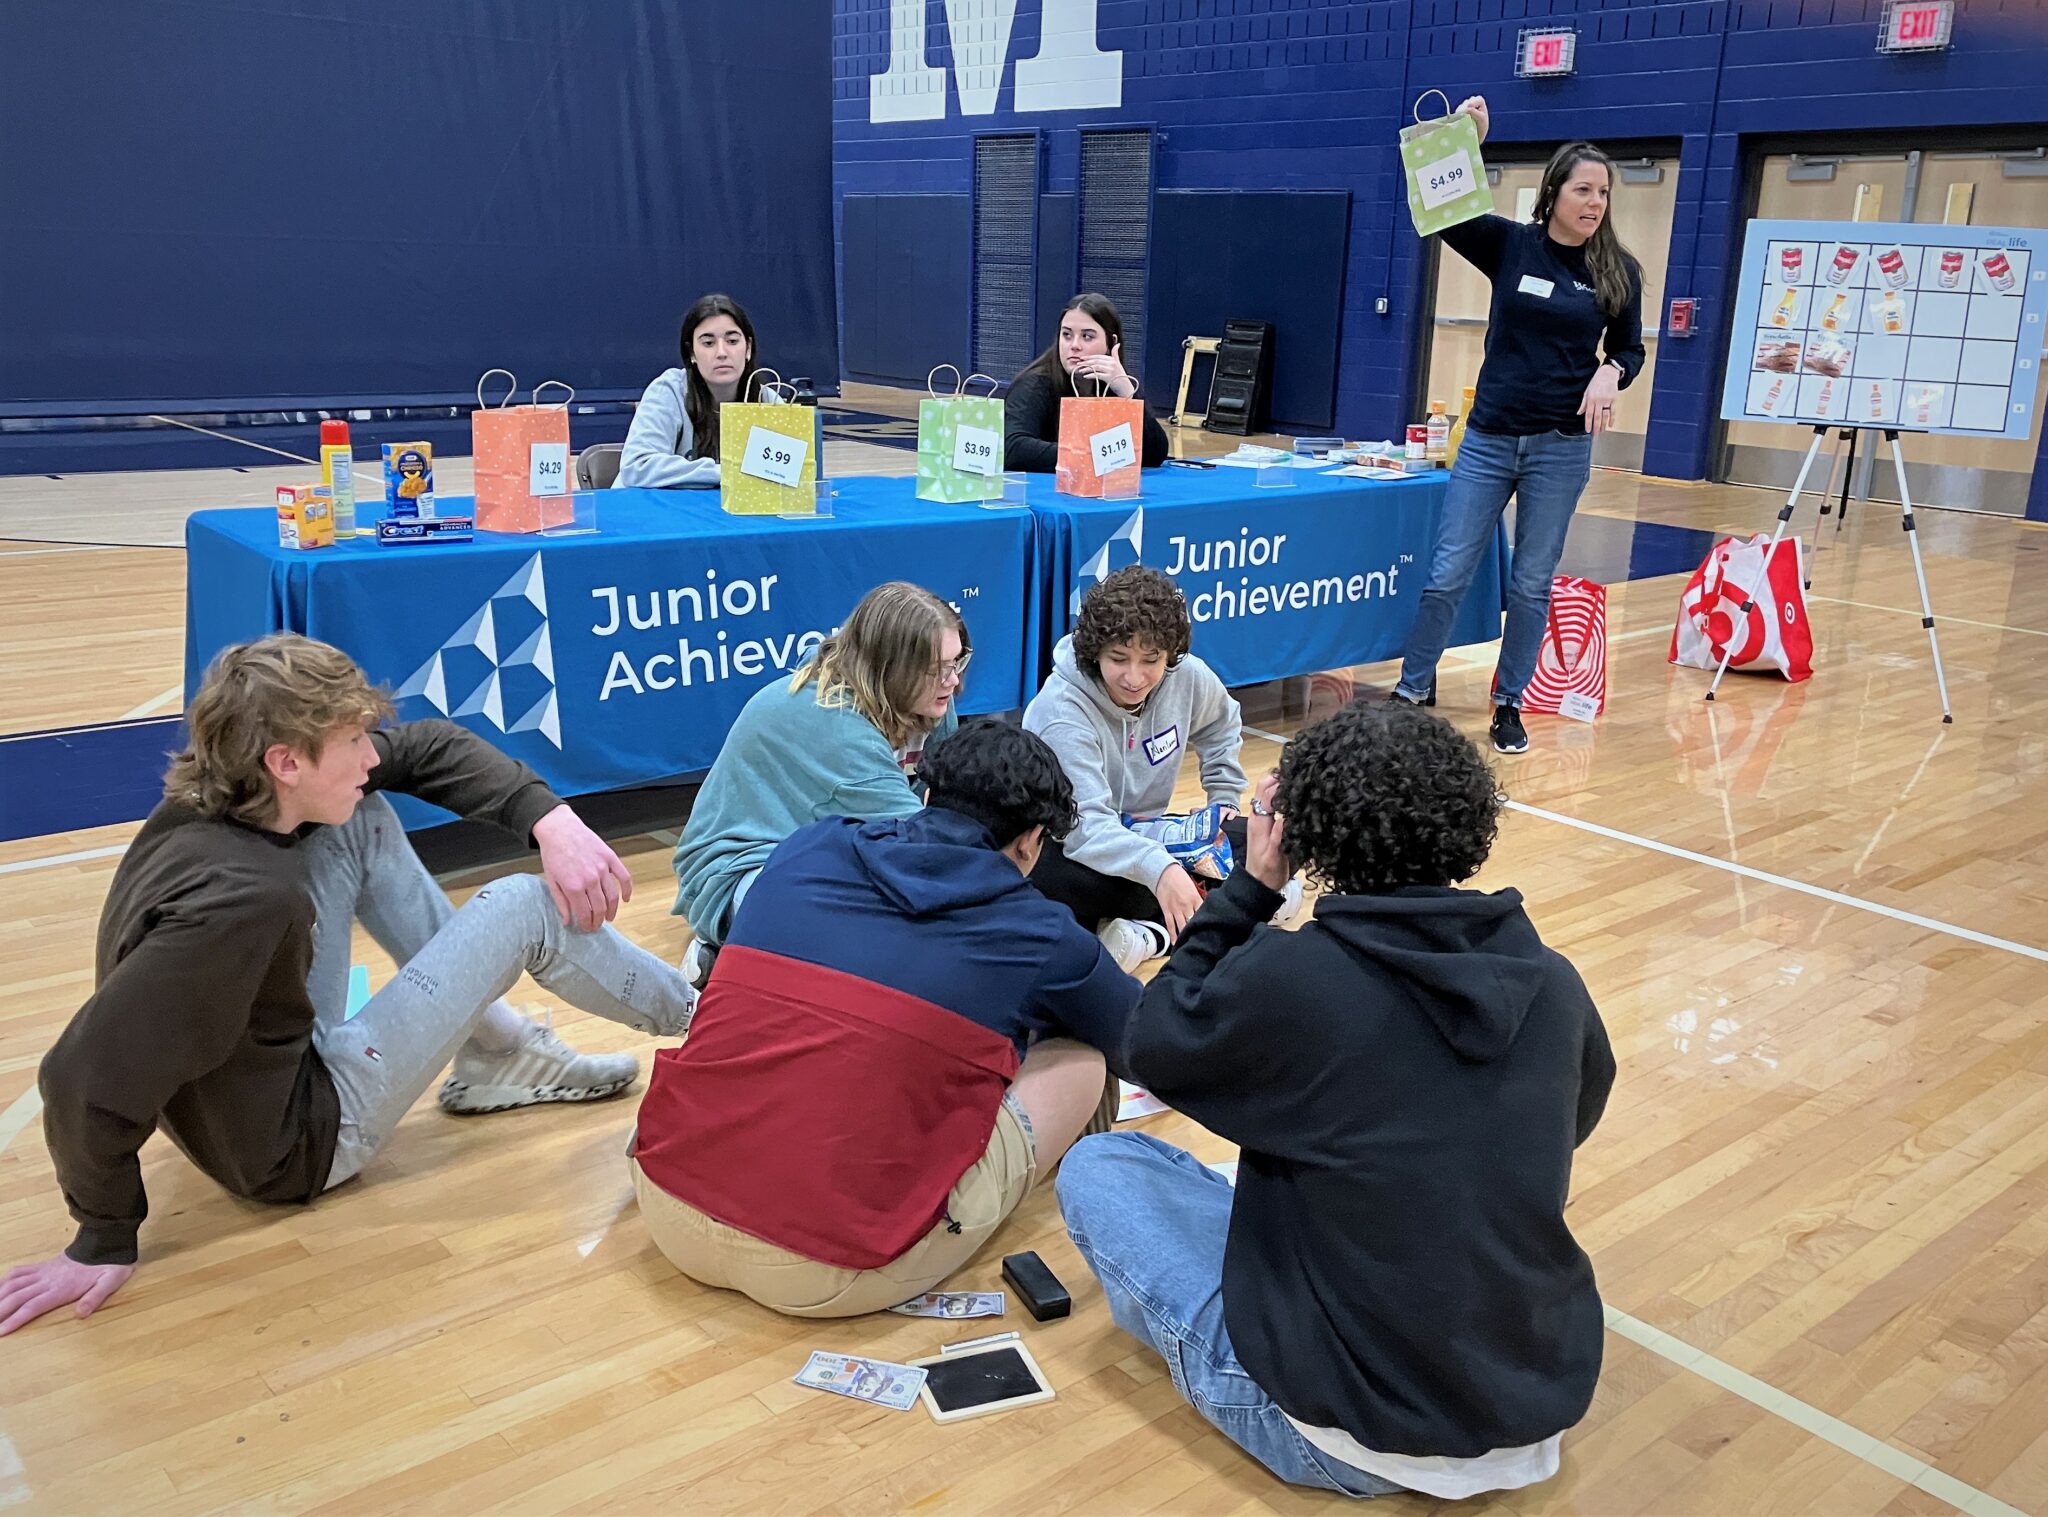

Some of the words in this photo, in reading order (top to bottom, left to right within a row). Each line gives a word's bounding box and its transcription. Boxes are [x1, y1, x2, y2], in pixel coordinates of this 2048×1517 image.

[1900, 9, 1938, 40] EXIT
[869, 0, 1123, 123] M
[1534, 39, 1562, 67] EXIT
[1430, 167, 1463, 190] $4.99
[2009, 237, 2028, 247] life
[762, 446, 791, 465] $.99
[964, 441, 991, 457] $3.99
[1101, 438, 1127, 457] $1.19
[538, 460, 562, 475] $4.29
[383, 525, 425, 537] Crest
[1165, 527, 1287, 576] Junior
[590, 568, 779, 638] Junior
[1177, 564, 1399, 624] chievement
